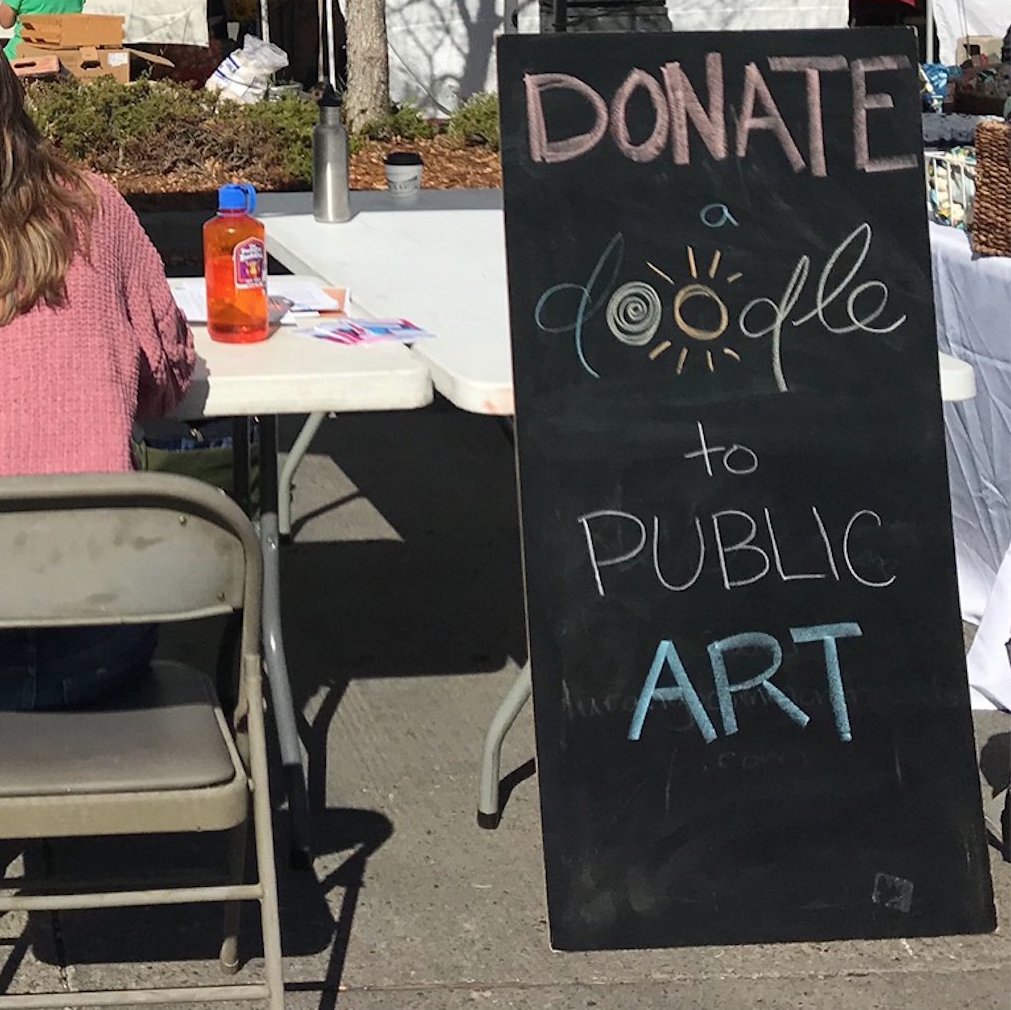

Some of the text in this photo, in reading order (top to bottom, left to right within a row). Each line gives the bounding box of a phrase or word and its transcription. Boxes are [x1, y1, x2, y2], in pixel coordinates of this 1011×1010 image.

[524, 51, 918, 177] DONATE
[699, 202, 739, 228] a
[534, 222, 907, 392] doodle
[684, 421, 759, 476] to
[578, 506, 896, 596] PUBLIC
[627, 621, 862, 743] ART
